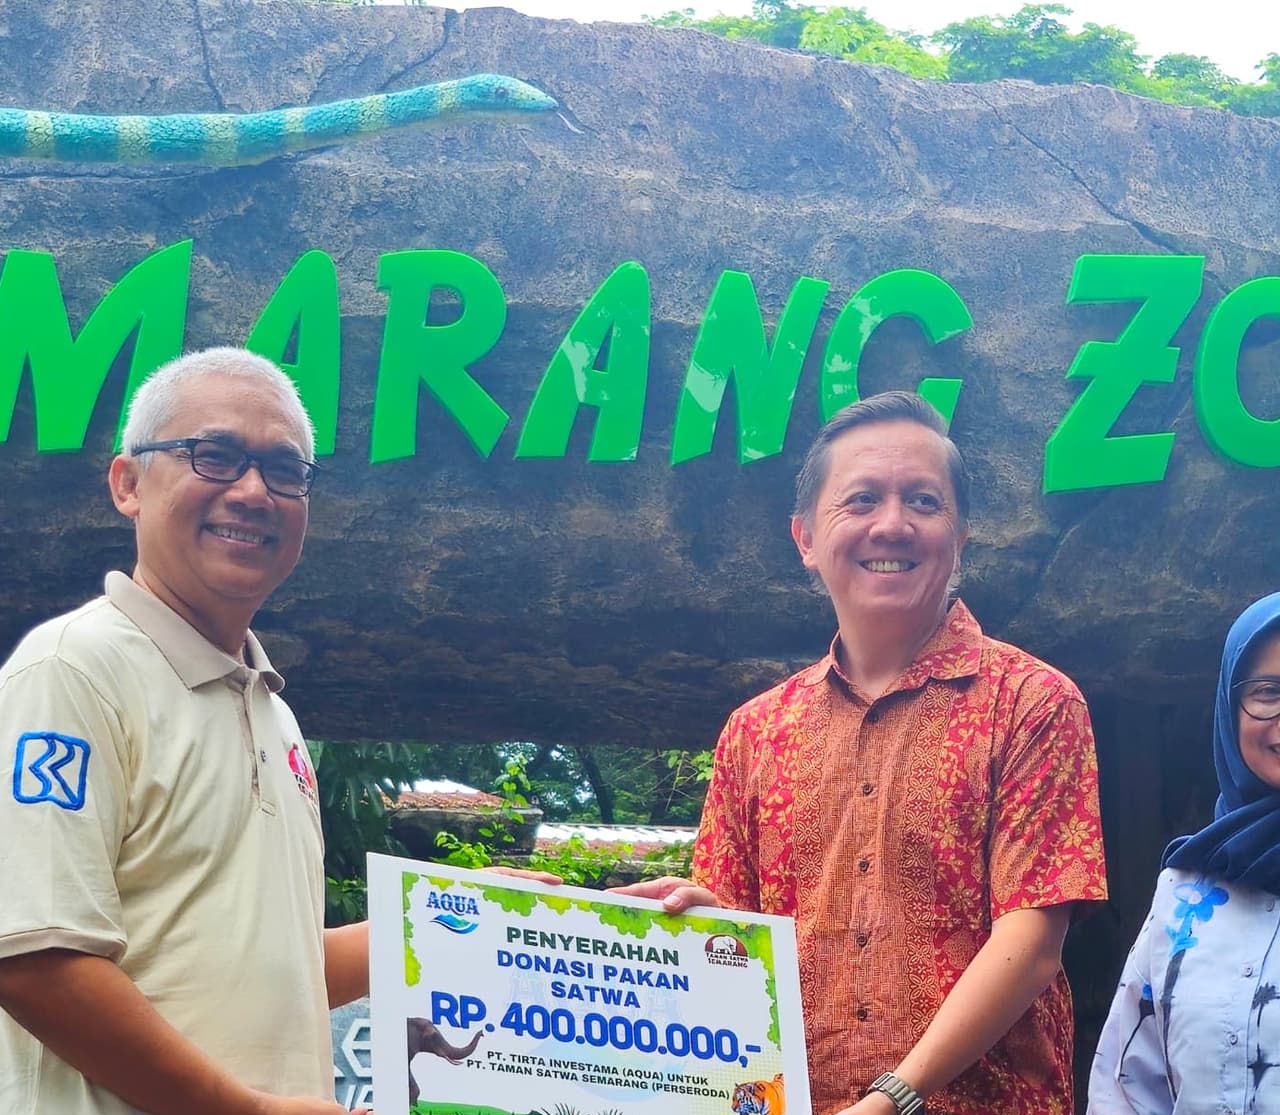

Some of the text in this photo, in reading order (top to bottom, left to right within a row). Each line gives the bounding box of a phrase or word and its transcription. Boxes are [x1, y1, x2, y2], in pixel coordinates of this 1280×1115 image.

[426, 891, 480, 916] AQUA
[506, 926, 680, 967] PENYERAHAN
[707, 957, 748, 968] SEMARANG
[497, 949, 690, 992] DONASI PAKAN
[550, 980, 641, 1009] SATWA
[430, 990, 762, 1068] RP. 400.000.000,-
[466, 1059, 730, 1100] PT. TAMAN SATWA SEMARANG (PERSERODA)
[486, 1050, 709, 1086] PT. TIRTA INVESTAMA (AQUA) UNTUK
